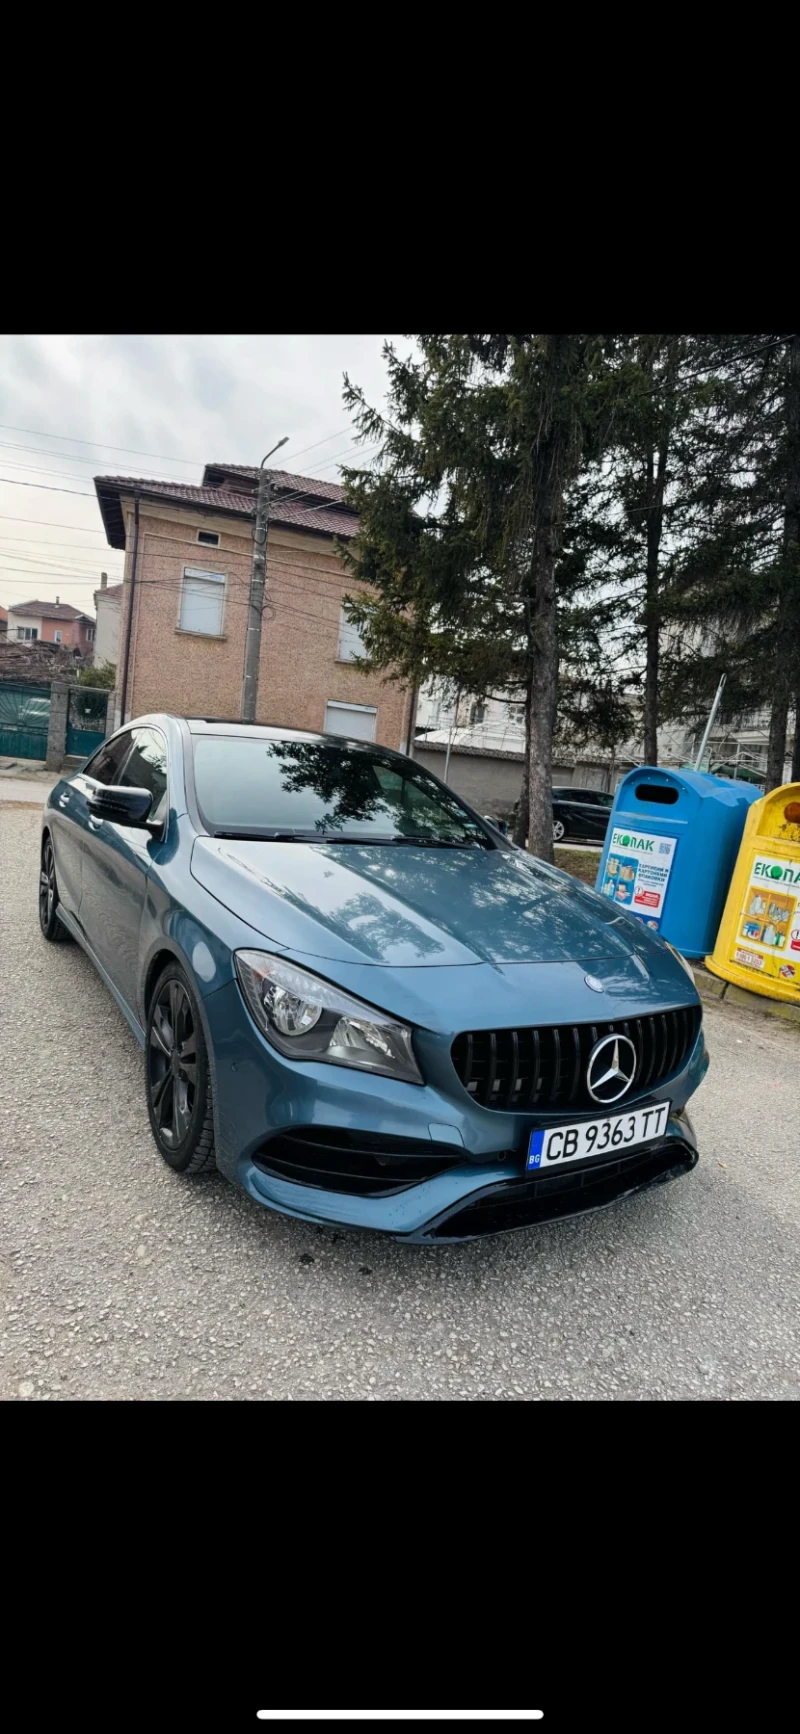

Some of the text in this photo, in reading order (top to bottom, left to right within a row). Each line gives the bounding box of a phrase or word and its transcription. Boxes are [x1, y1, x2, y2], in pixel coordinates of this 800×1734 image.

[612, 833, 655, 852] ЕКОПАК
[546, 1107, 666, 1161] CB 9363 TT
[529, 1154, 540, 1165] BG
